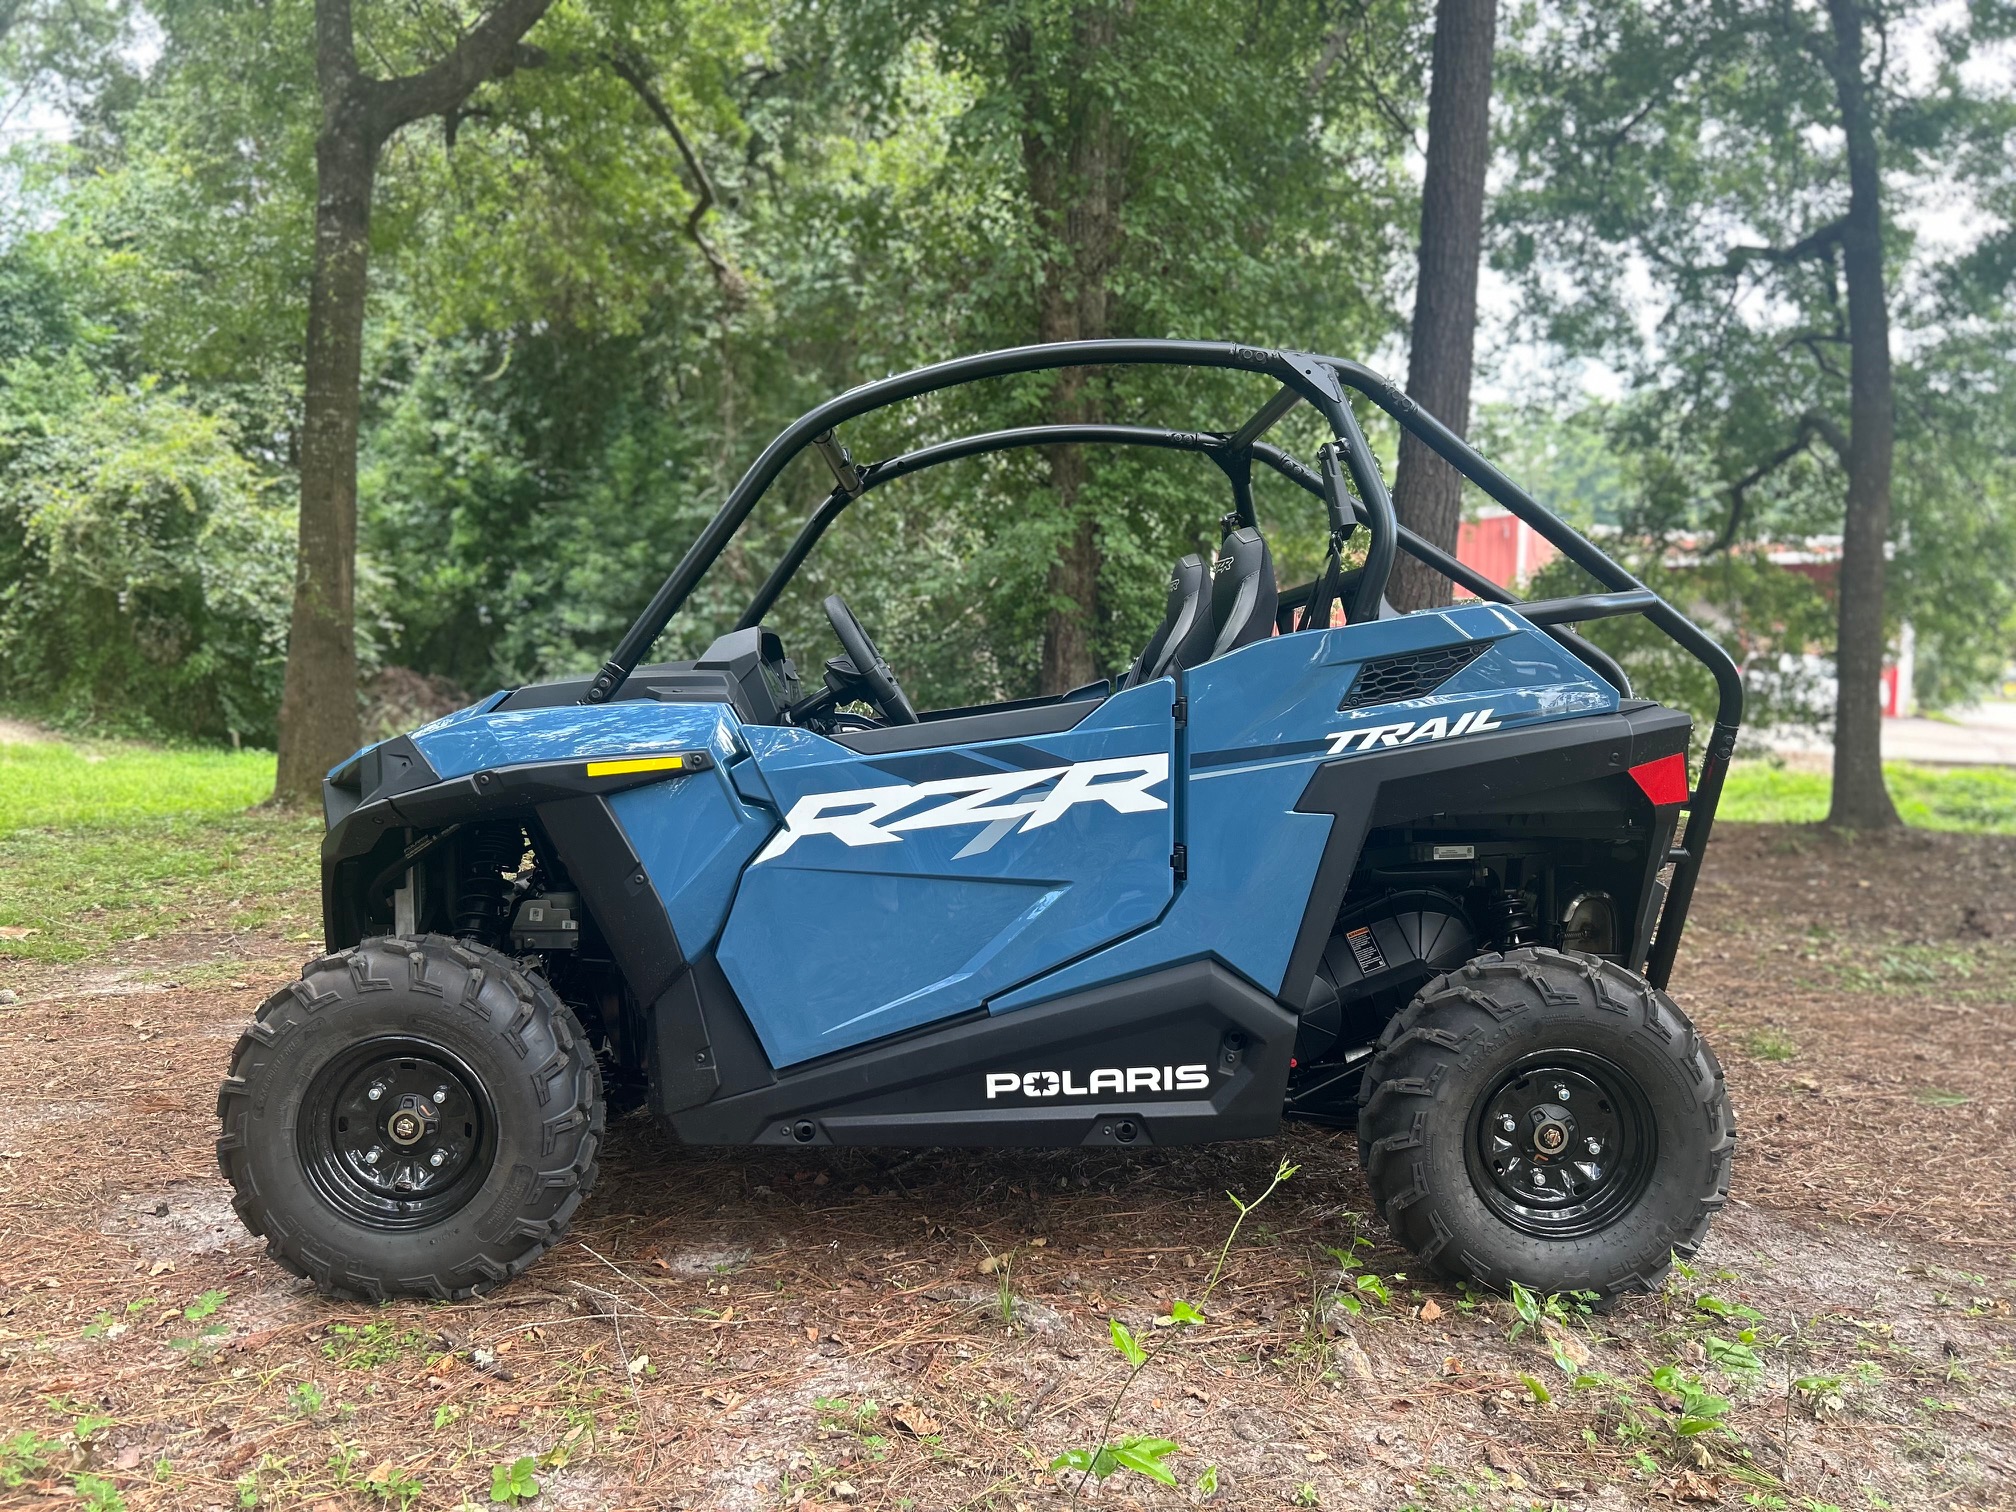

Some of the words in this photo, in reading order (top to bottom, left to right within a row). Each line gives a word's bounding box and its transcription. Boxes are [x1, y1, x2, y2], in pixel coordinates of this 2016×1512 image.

[1325, 708, 1502, 755] TRAIL
[752, 752, 1170, 865] RZR
[986, 1065, 1210, 1099] POLARIS
